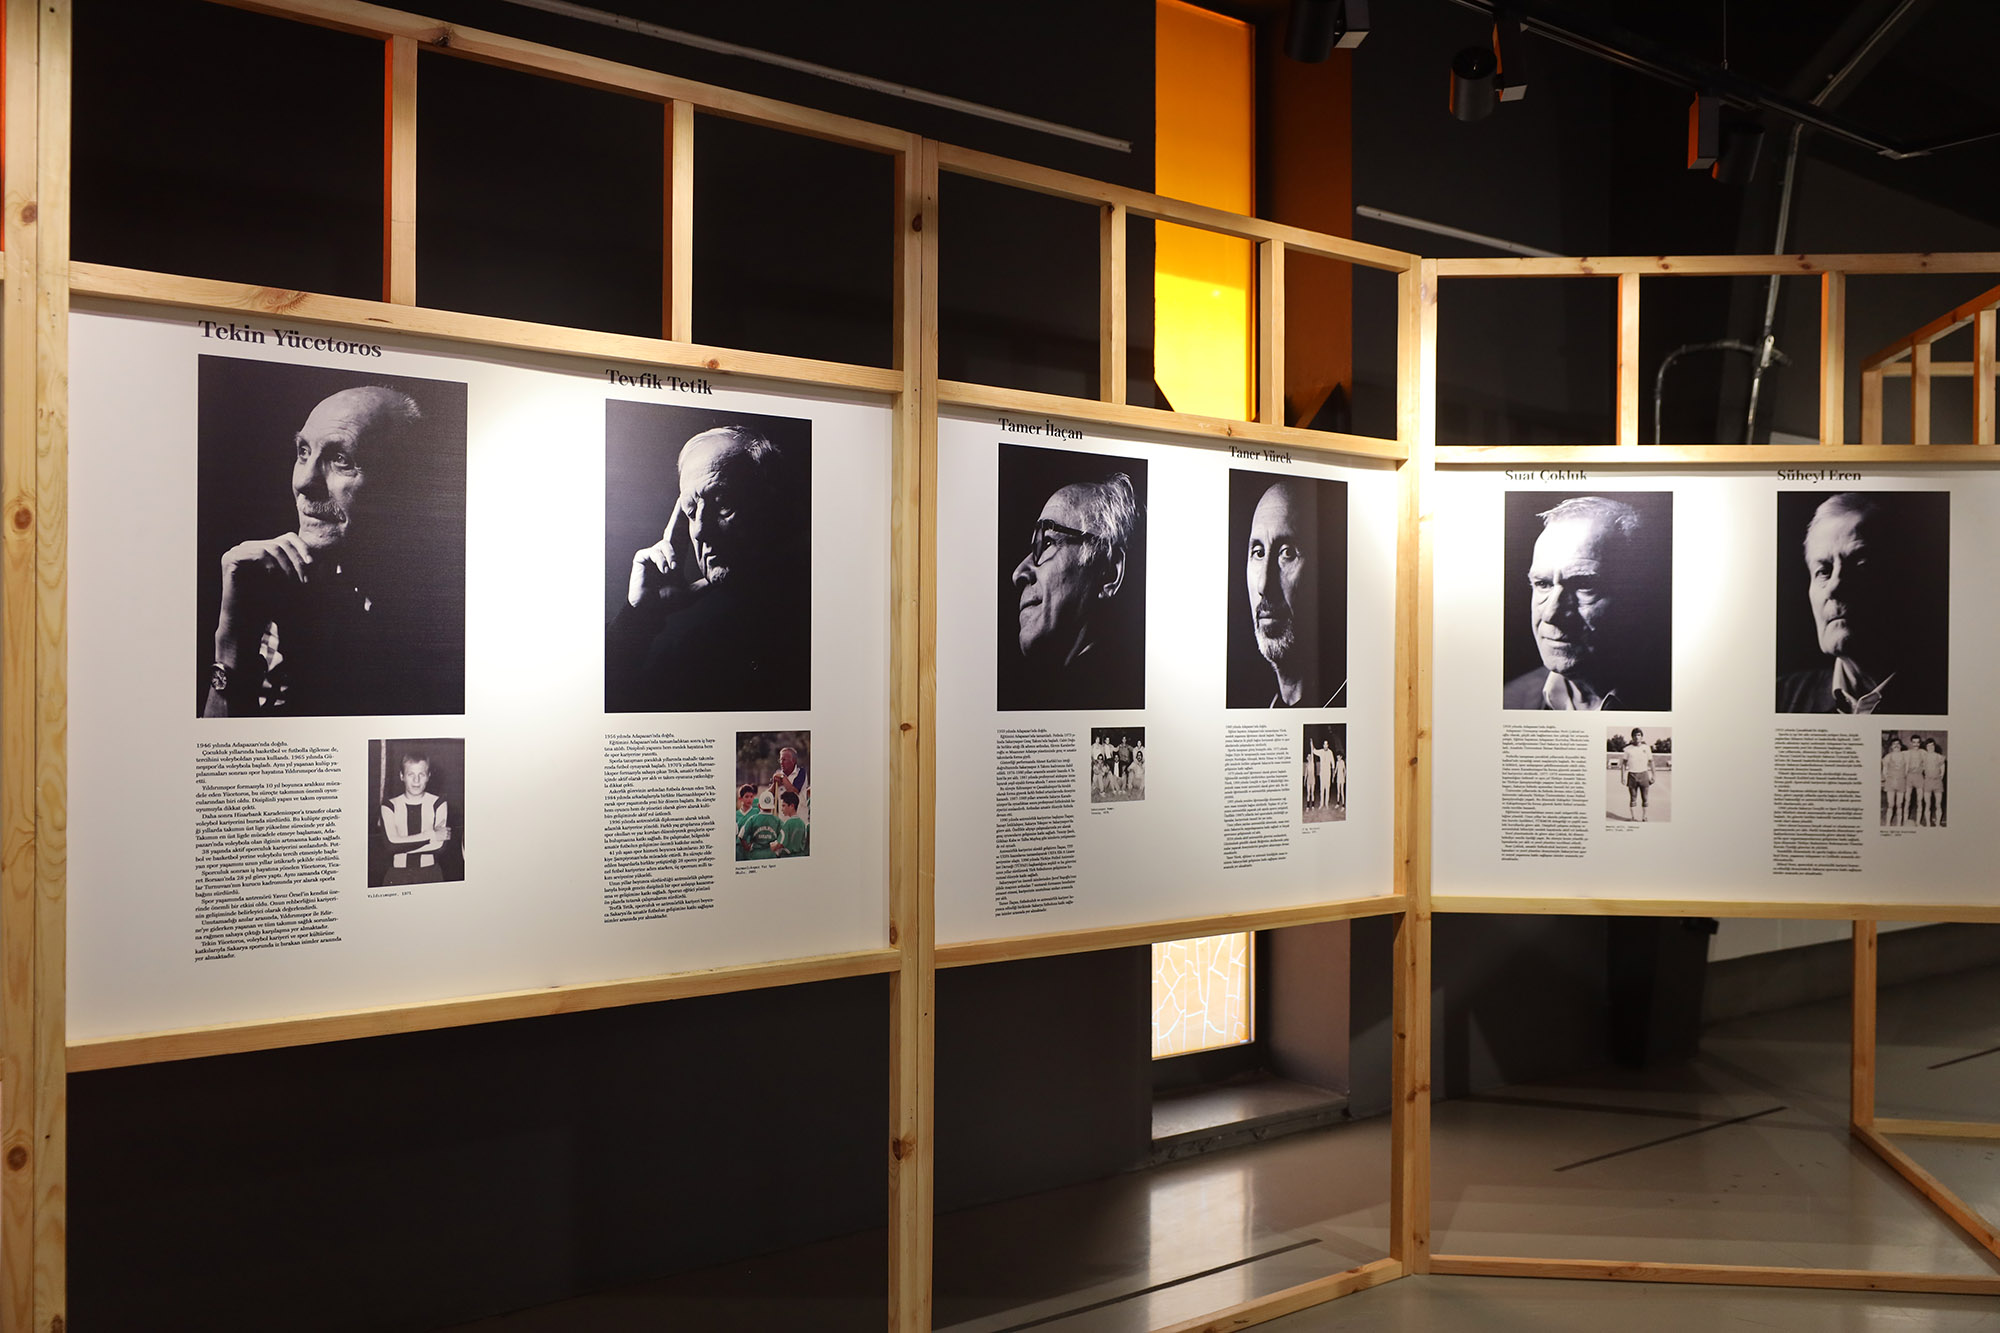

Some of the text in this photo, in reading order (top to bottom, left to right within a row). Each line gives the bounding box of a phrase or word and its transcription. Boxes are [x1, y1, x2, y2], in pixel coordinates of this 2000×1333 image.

[198, 320, 382, 358] Tekin Yücetoros
[606, 369, 712, 395] Tevfik Tetik
[998, 417, 1083, 441] Tamer İlaçan
[1229, 445, 1292, 464] Taner Yürek
[1505, 469, 1587, 484] Suat Çokluk
[1777, 469, 1862, 484] Süheyl Eren
